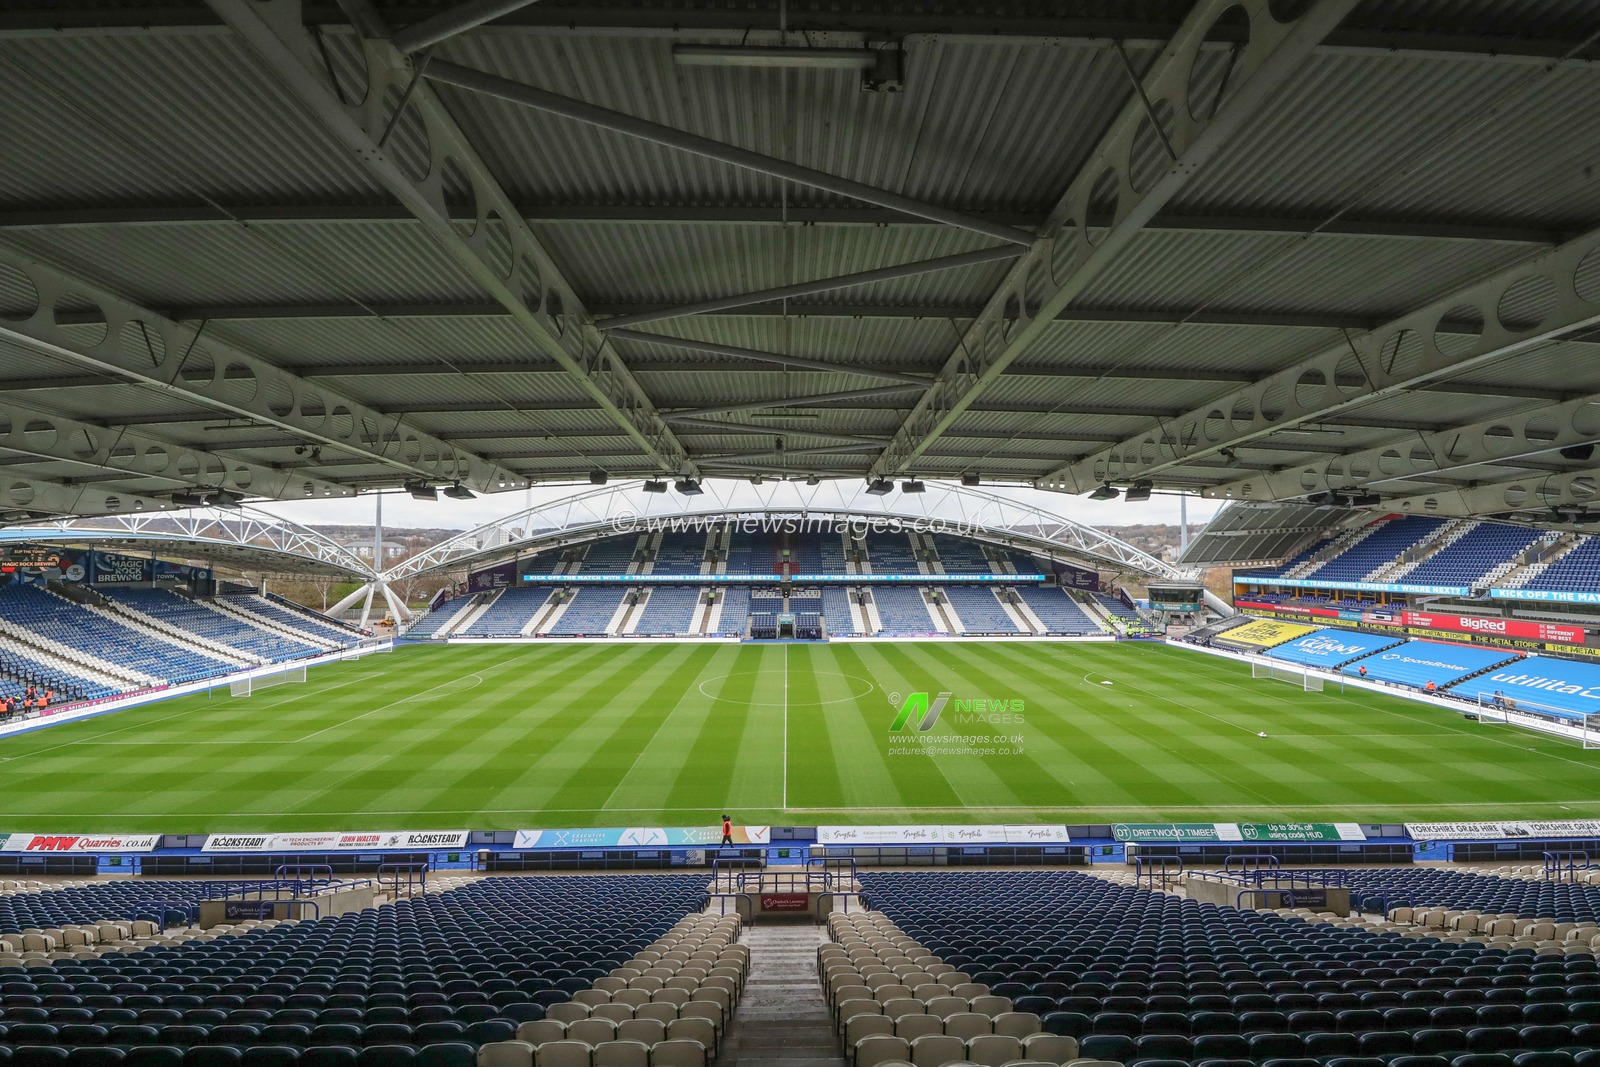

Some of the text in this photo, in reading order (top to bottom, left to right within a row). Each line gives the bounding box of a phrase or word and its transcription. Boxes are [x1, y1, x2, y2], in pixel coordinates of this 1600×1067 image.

[112, 560, 143, 568] MAGIC
[115, 567, 142, 575] ROCK
[98, 574, 142, 582] BREWING
[1309, 580, 1357, 588] TRANSPENNINE
[1357, 583, 1389, 591] EXPRESS
[1432, 586, 1461, 594] NEXT?
[1499, 590, 1524, 598] KICK
[1526, 590, 1549, 599] OFF
[1551, 592, 1574, 600] THE
[1460, 617, 1505, 631] BigRed
[1489, 637, 1512, 645] METAL
[1514, 640, 1537, 648] STORE
[1552, 644, 1599, 656] THE METAL
[1400, 656, 1470, 671] SportsBroker
[1490, 673, 1583, 694] utilita
[1538, 721, 1569, 733] Surveying
[1243, 827, 1257, 836] DT
[1410, 825, 1455, 833] YORKSHIRE
[1480, 824, 1499, 832] HIRE
[1528, 823, 1574, 831] YORKSHIRE
[1574, 822, 1598, 830] GRAB
[1116, 828, 1129, 837] DT
[1132, 828, 1185, 837] DRIFTWOOD
[1185, 828, 1218, 837] TIMBER
[1268, 832, 1288, 840] using
[26, 836, 80, 850] PMW
[211, 836, 267, 847] ROCKSTEADY
[407, 833, 462, 844] ROCKSTEADY
